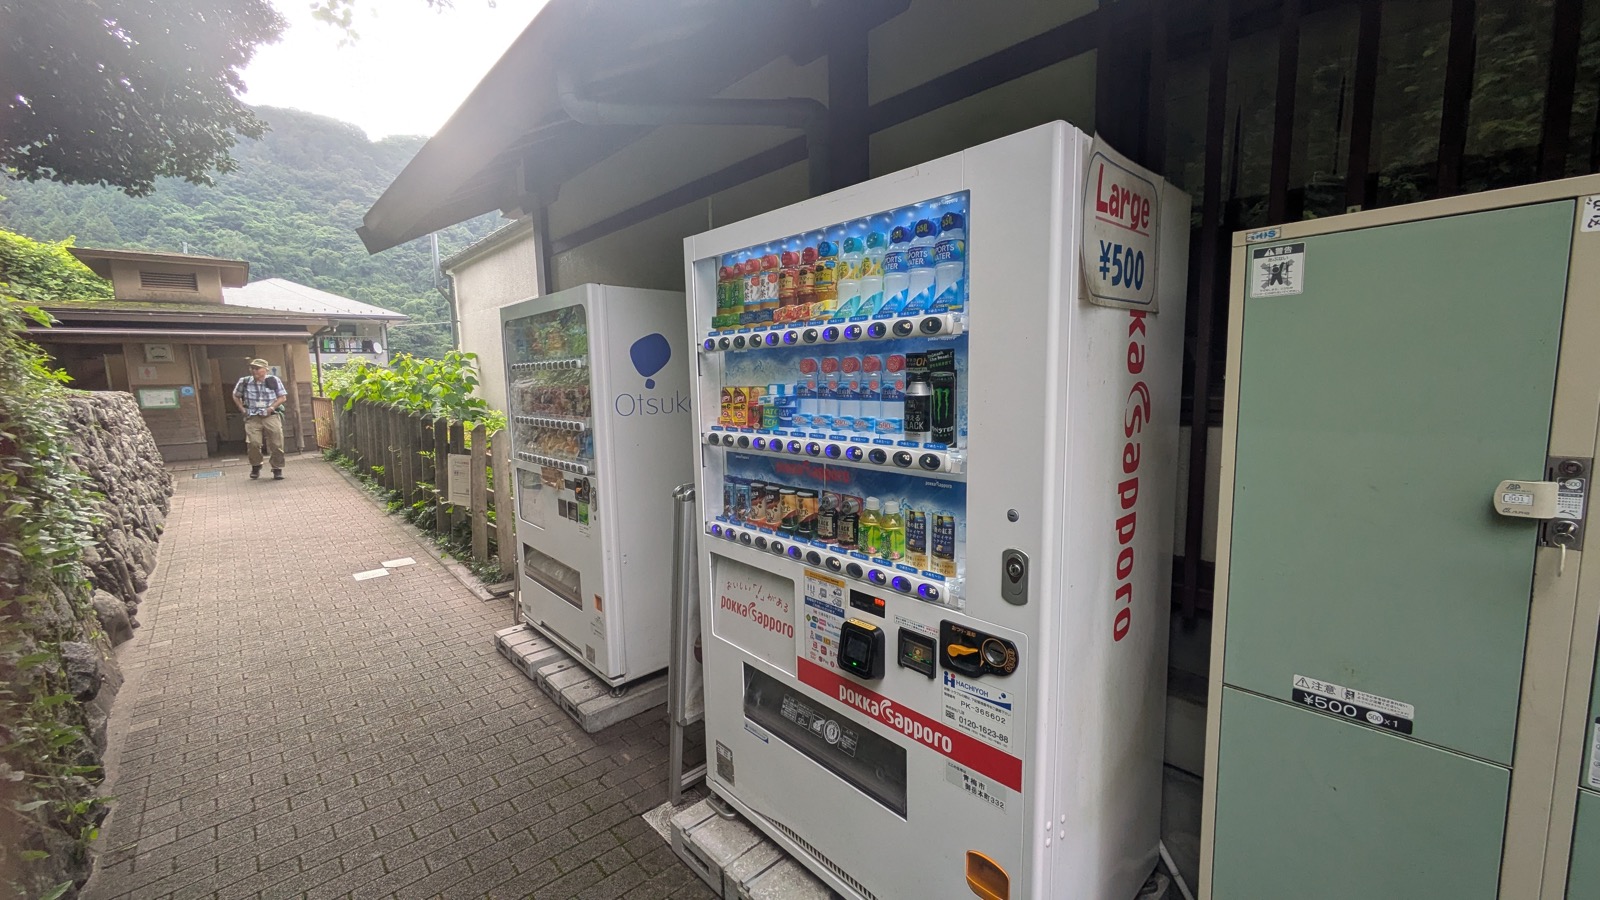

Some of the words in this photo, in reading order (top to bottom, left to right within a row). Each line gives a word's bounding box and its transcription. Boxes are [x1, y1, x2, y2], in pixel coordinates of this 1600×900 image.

[1096, 163, 1150, 230] Large
[1099, 240, 1145, 290] ¥500
[721, 595, 748, 617] pokka
[748, 602, 794, 638] sapporo
[956, 680, 989, 697] HACHIYOH
[1311, 680, 1337, 695] 注意
[960, 700, 1006, 724] PK-365602
[1304, 693, 1357, 717] ¥500
[1368, 713, 1382, 722] 500
[839, 685, 879, 717] pokka
[880, 699, 953, 753] sapporo
[959, 716, 1009, 744] 0120-1623-88
